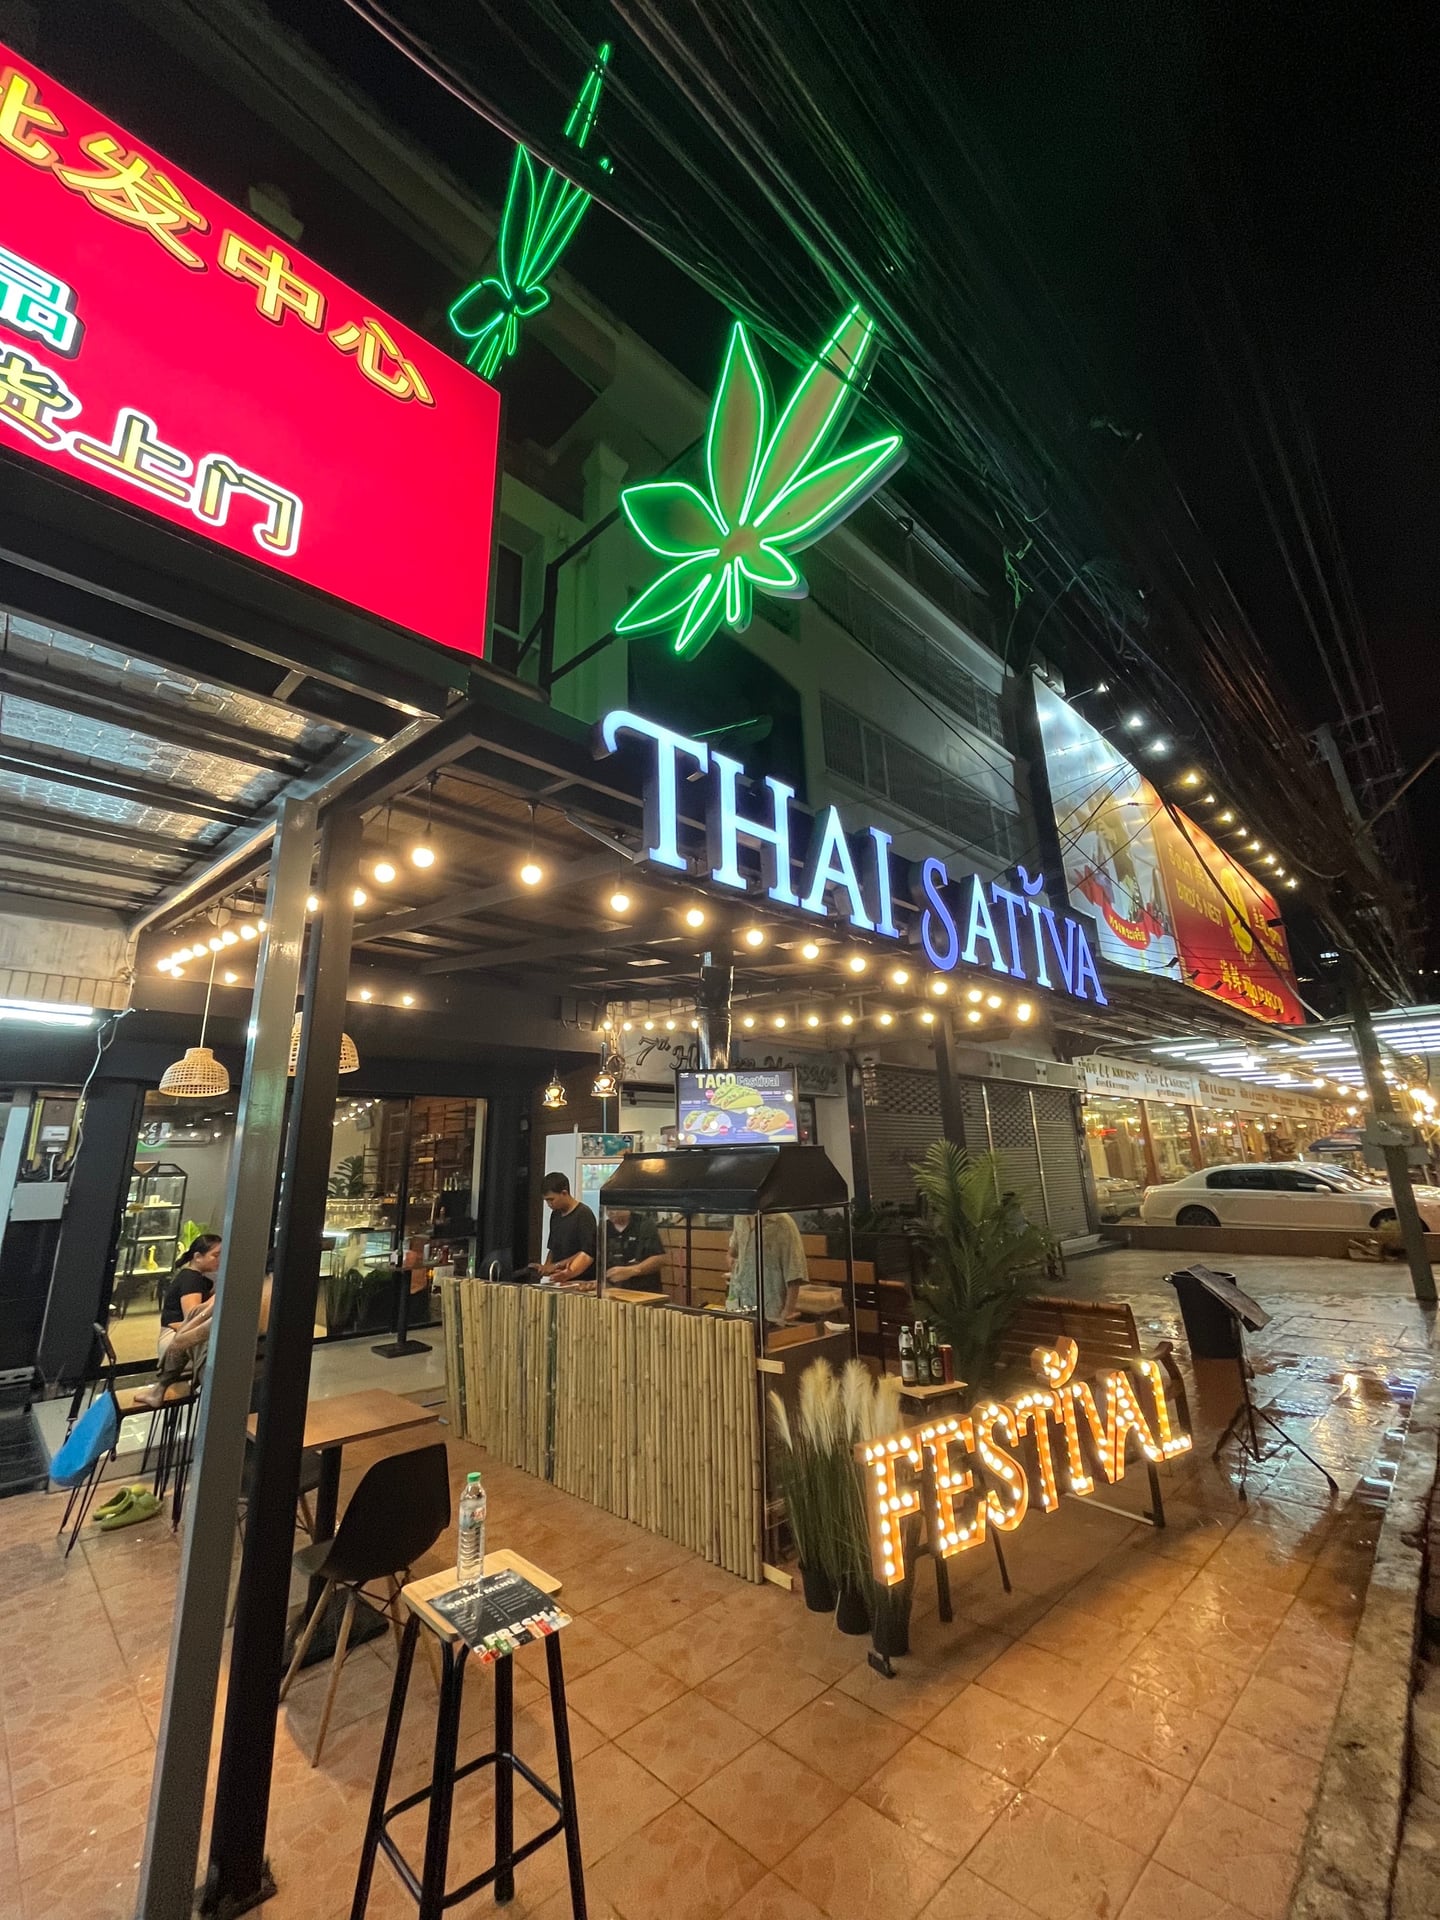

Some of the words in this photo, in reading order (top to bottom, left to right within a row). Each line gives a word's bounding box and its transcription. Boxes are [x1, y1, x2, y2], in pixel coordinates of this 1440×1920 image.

[601, 709, 899, 939] THAI
[695, 1073, 737, 1089] TACO
[736, 1074, 780, 1088] Festival
[856, 1337, 1193, 1586] FESTIVAL
[446, 1592, 484, 1609] DRINK
[483, 1577, 517, 1595] MENU
